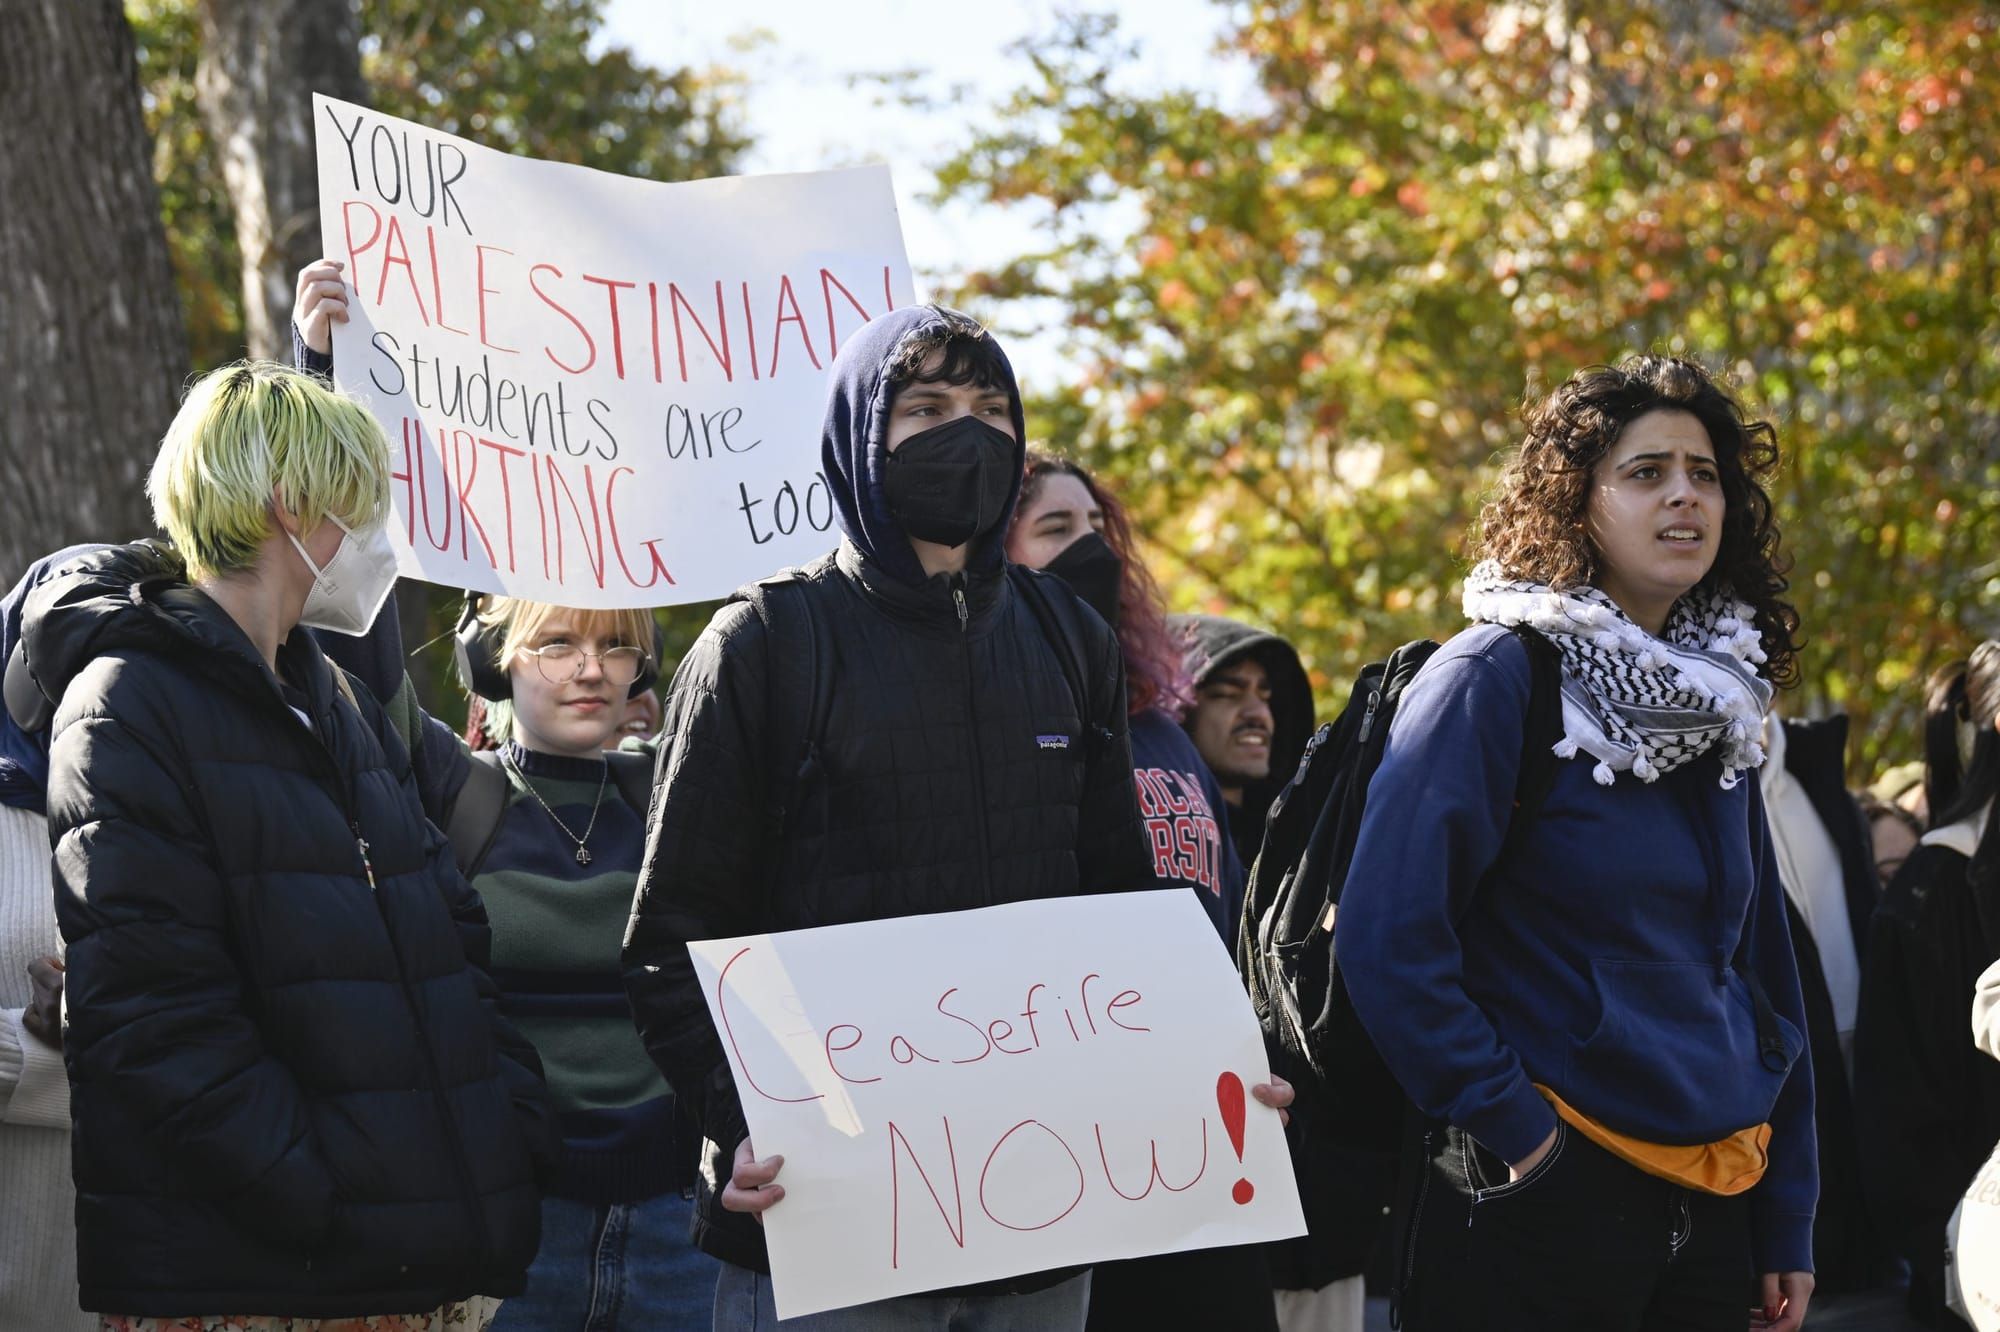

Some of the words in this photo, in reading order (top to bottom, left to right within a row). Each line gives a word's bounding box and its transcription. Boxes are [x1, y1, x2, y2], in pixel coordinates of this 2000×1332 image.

[325, 105, 472, 236] YOUR
[343, 201, 894, 384] PALESTINIAN
[667, 404, 762, 460] are
[739, 471, 833, 545] too
